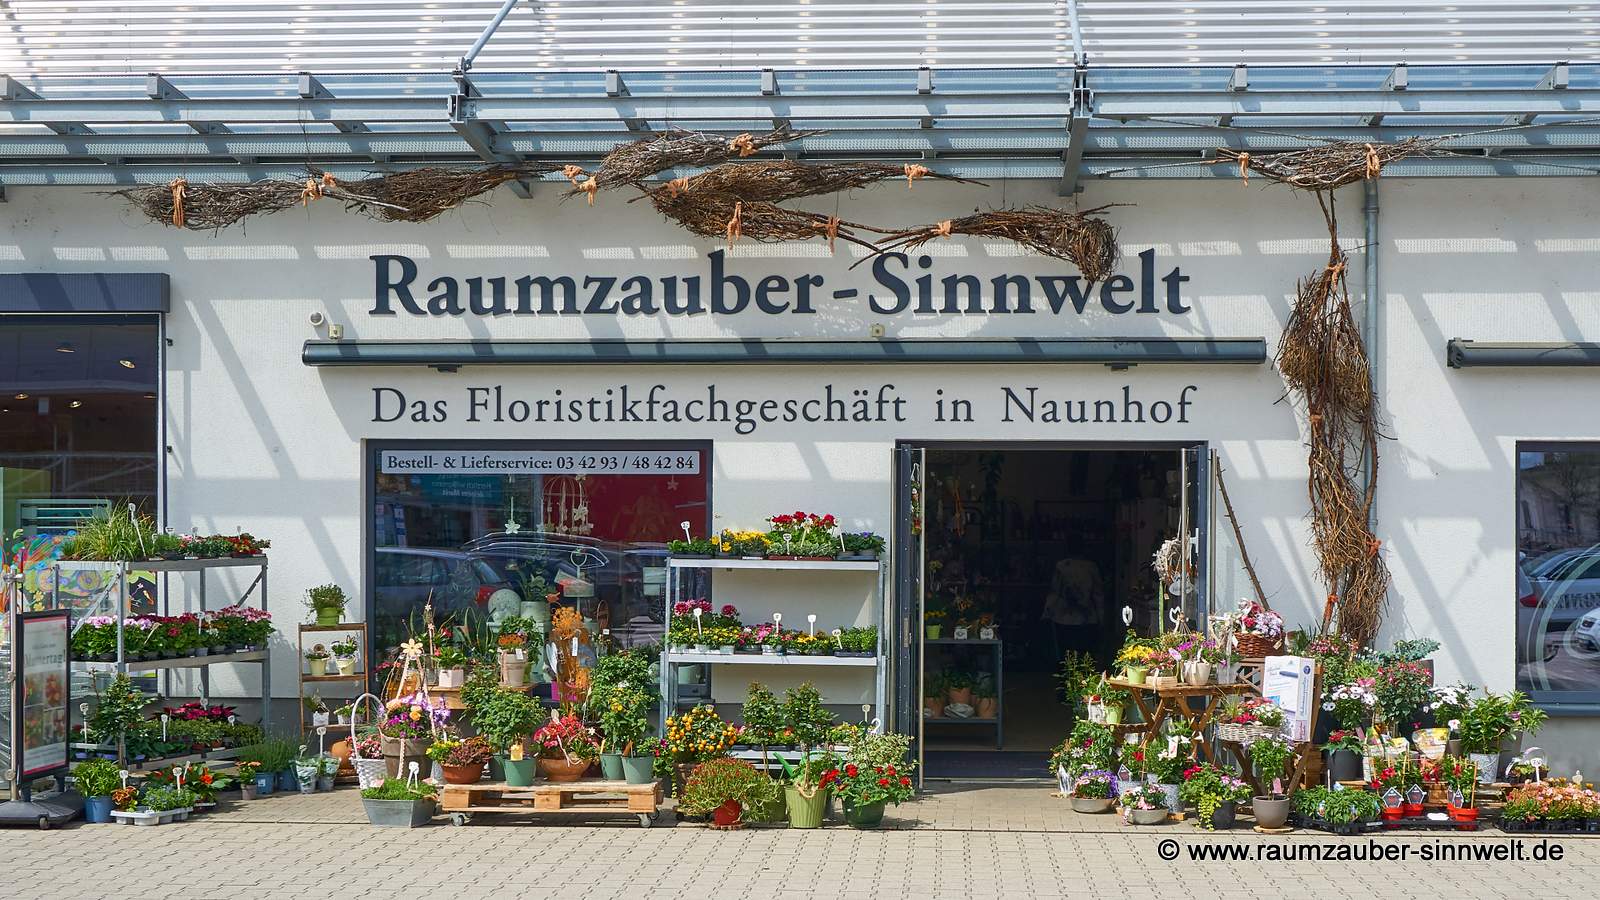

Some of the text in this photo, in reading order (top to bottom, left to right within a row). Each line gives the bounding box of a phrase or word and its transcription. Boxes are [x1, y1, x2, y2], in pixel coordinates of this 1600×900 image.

[369, 249, 1191, 316] Raumzauber-Sinnwelt
[372, 383, 1198, 435] Das Floristikfachgeschäft in Naunhof
[388, 455, 694, 470] Bestell- & Lieferservice: 03 42 93 / 48 42 84
